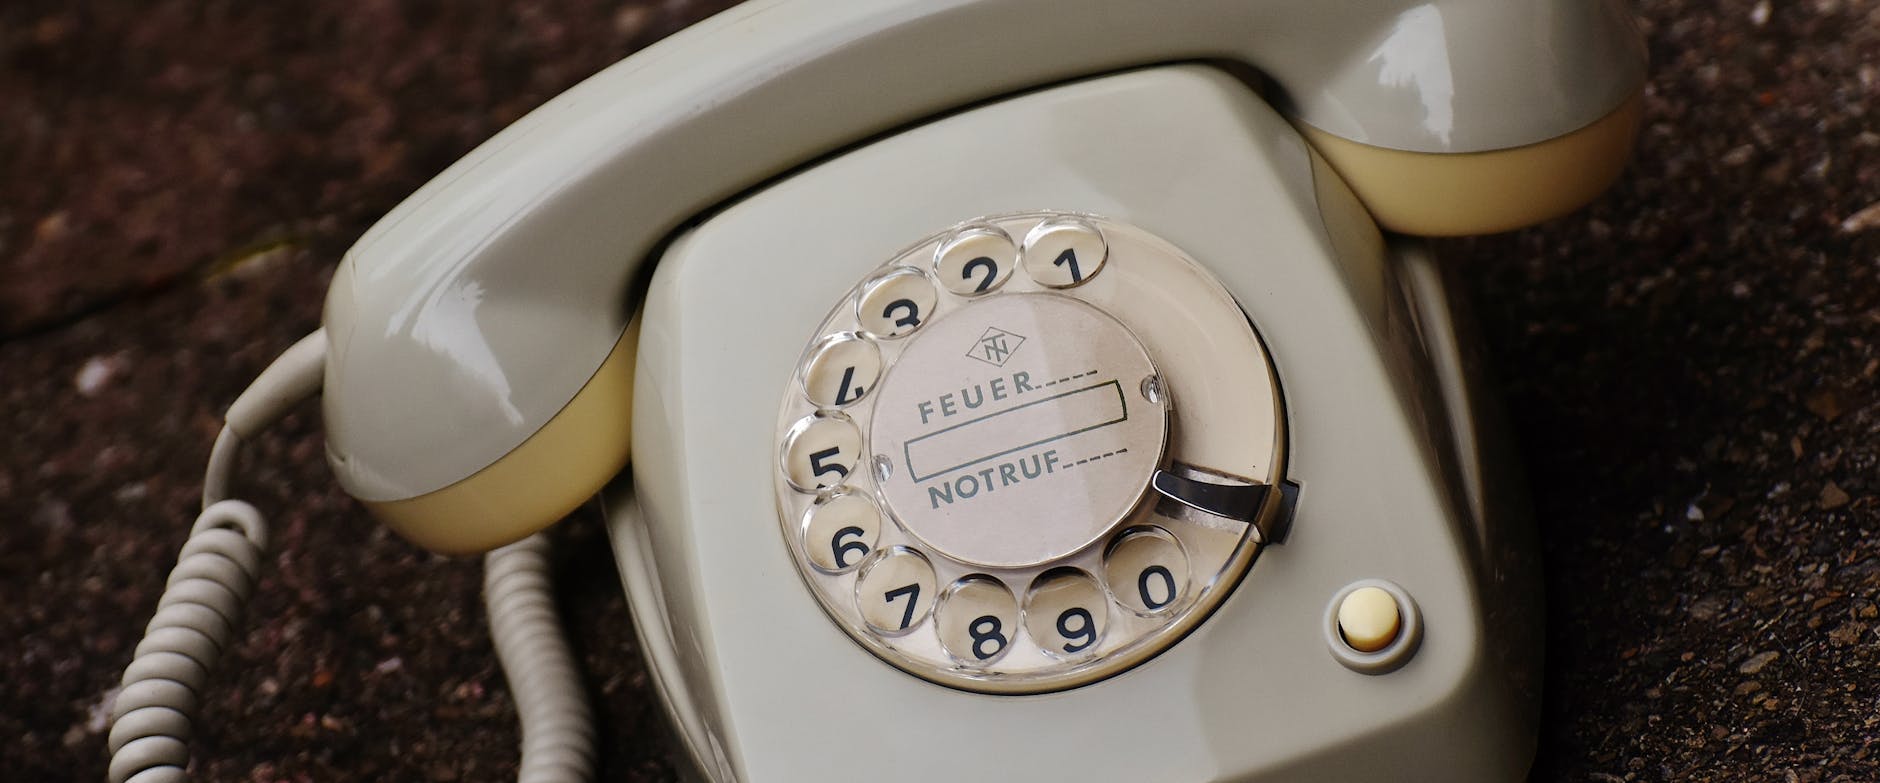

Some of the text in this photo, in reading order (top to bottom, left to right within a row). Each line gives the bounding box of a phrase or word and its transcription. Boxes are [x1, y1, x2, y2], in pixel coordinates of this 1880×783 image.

[961, 256, 998, 292] 2
[1053, 248, 1082, 284] 1
[883, 298, 921, 336] 3
[835, 366, 864, 406] 4
[917, 371, 1036, 424] FEUER
[810, 446, 849, 488] 5
[927, 449, 1060, 509] NOTRUF
[831, 526, 870, 568] 6
[884, 583, 921, 630] 7
[1138, 564, 1177, 610] 0
[968, 615, 1008, 660] 8
[1056, 607, 1096, 653] 9
